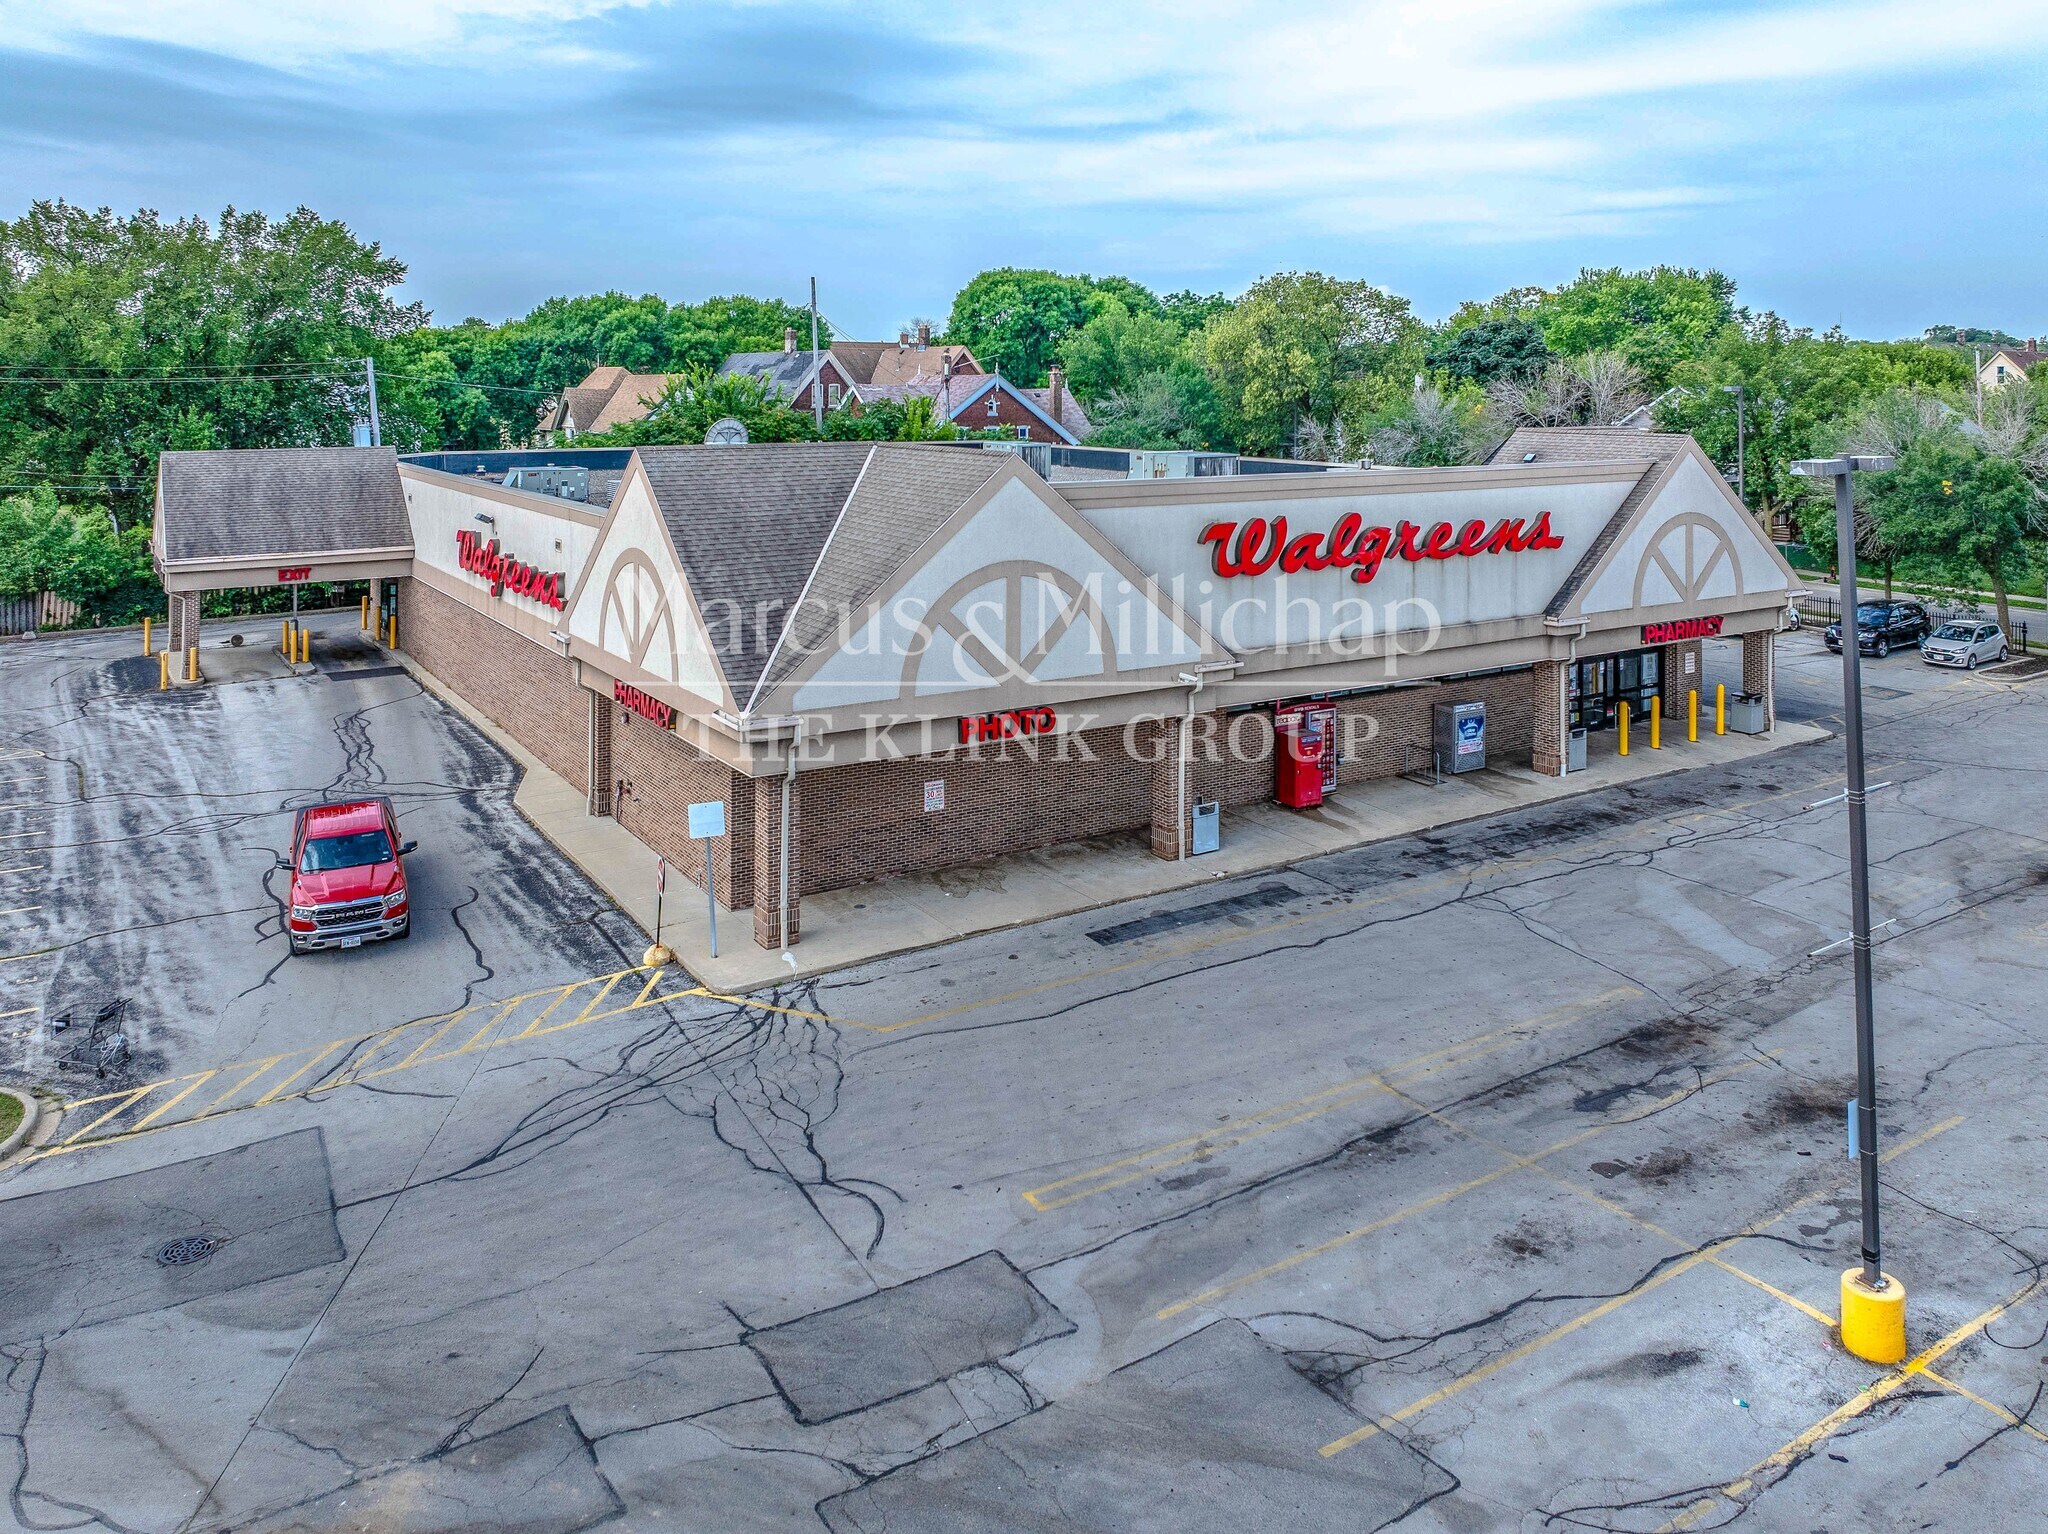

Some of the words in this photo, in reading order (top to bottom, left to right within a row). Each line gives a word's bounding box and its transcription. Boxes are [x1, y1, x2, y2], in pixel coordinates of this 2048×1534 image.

[1197, 511, 1564, 584] Walgreens
[278, 566, 312, 583] EXIT
[456, 529, 568, 612] Walgreens
[1643, 616, 1725, 645] PHARMACY
[613, 678, 672, 730] PHARMACY
[958, 706, 1056, 744] PHOTO
